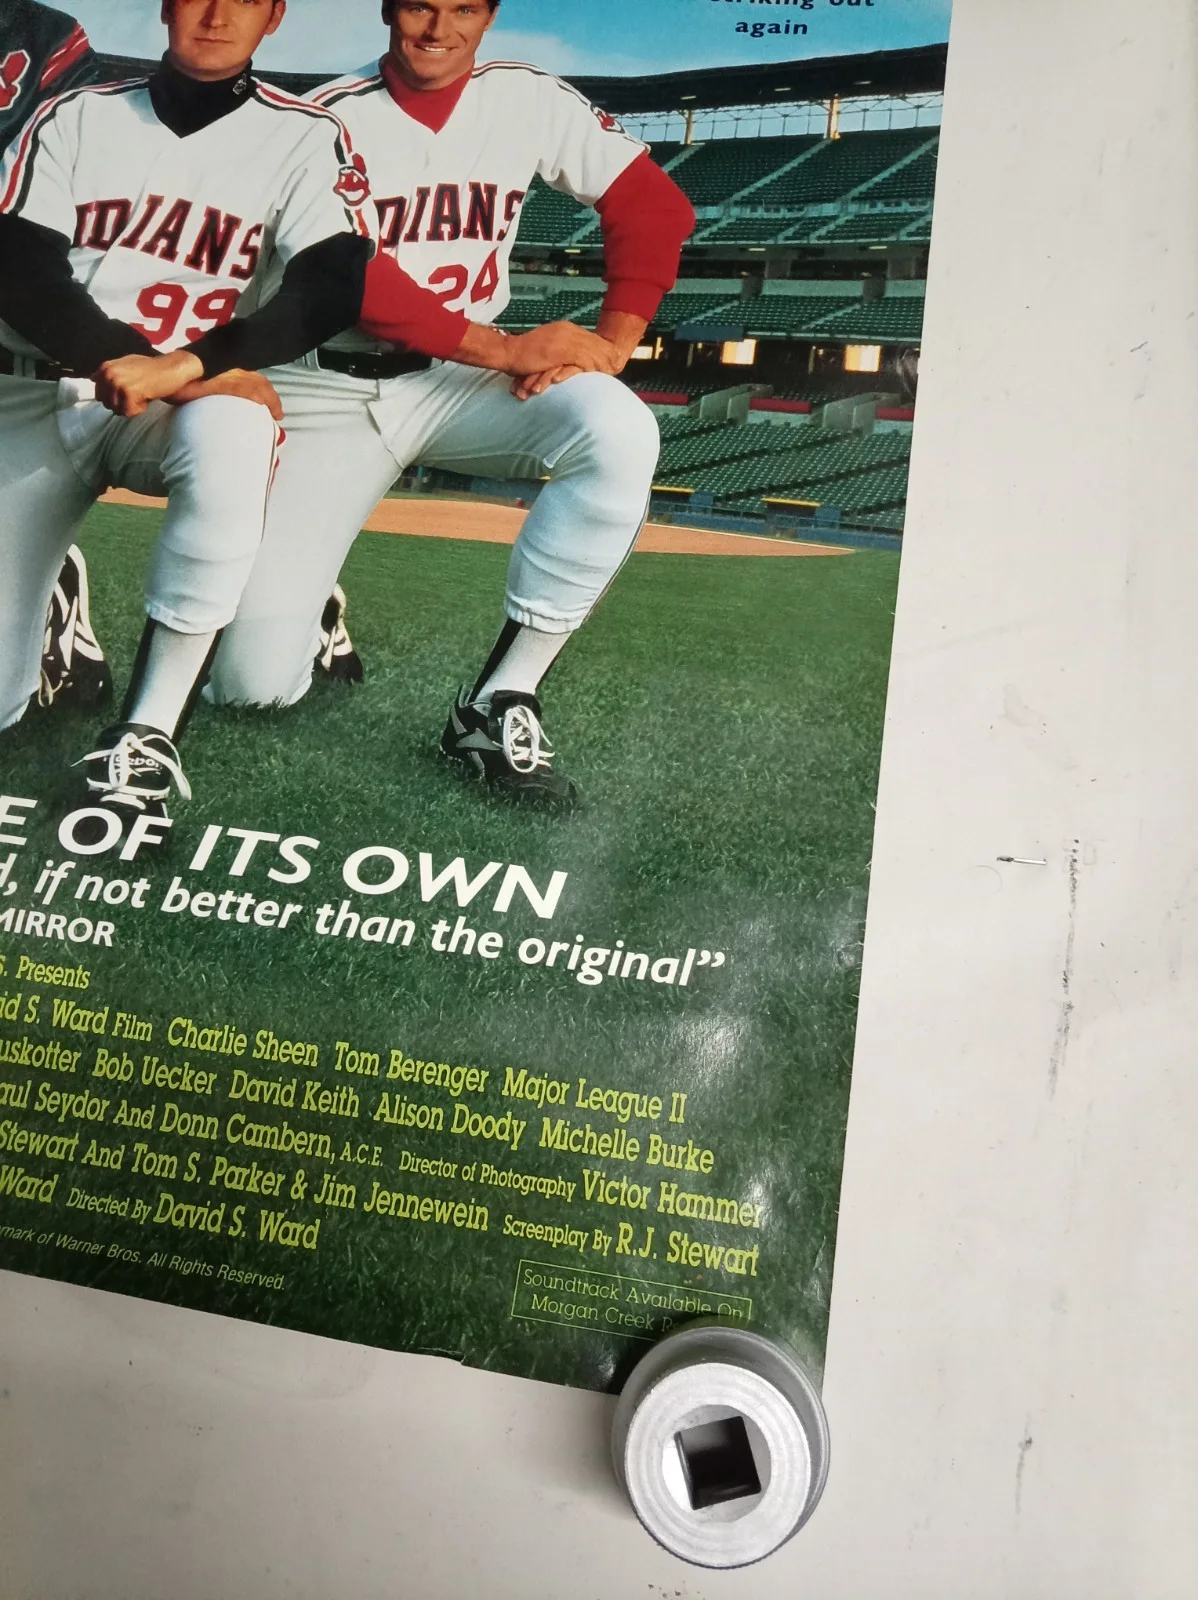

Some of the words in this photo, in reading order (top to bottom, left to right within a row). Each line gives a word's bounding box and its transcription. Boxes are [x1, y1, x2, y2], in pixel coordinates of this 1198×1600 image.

[735, 19, 808, 38] again
[129, 282, 241, 345] 99
[58, 807, 173, 861] OF
[188, 824, 320, 884] ITS
[342, 845, 568, 919] OWN
[33, 859, 77, 905] if
[74, 873, 151, 909] not
[160, 876, 303, 929] better
[315, 900, 416, 947] than
[431, 915, 504, 959] the
[15, 955, 91, 990] Presents
[24, 994, 41, 1024] S.
[52, 998, 110, 1035] Ward
[112, 1012, 153, 1042] Film
[167, 1016, 248, 1056] Charlie
[252, 1029, 319, 1067] Sheen
[335, 1041, 380, 1076] Tom
[386, 1049, 489, 1097] Berenger
[501, 1066, 570, 1109] Major
[575, 1078, 663, 1123] League
[92, 1048, 135, 1082] Bob
[141, 1055, 218, 1095] Uecker
[228, 1070, 297, 1108] David
[301, 1080, 360, 1118] Keith
[373, 1092, 444, 1131] Alison
[451, 1103, 527, 1151] Doody
[538, 1116, 640, 1162] Michelle
[646, 1133, 715, 1174] Burke
[0, 1119, 80, 1162] Stewart
[81, 1140, 125, 1170] And
[131, 1143, 178, 1180] Tom
[183, 1151, 201, 1184] S.
[209, 1156, 286, 1197] Parker
[290, 1169, 308, 1200] &
[314, 1173, 357, 1209] Jim
[363, 1181, 489, 1231] Jennewein
[503, 1214, 590, 1253] Screenplay
[592, 1228, 613, 1257] By
[615, 1222, 657, 1260] R.J.
[666, 1230, 760, 1277] Stewart
[34, 1082, 110, 1122] Seydor
[113, 1100, 156, 1130] And
[159, 1102, 220, 1140] Donn
[226, 1113, 335, 1165] Cambern,
[339, 1141, 383, 1167] A.C.E.
[398, 1150, 459, 1179] Director
[462, 1161, 478, 1182] of
[479, 1163, 577, 1202] Photography
[582, 1169, 651, 1210] Victor
[657, 1181, 762, 1229] Hammer
[0, 1164, 59, 1203] Ward
[66, 1187, 130, 1217] Directed
[131, 1199, 152, 1225] By
[153, 1193, 226, 1234] David
[228, 1205, 246, 1238] S.
[257, 1209, 322, 1251] Ward
[36, 1232, 56, 1245] of
[55, 1233, 105, 1256] Warner
[107, 1242, 141, 1264] Bros.
[147, 1251, 167, 1269] All
[168, 1254, 215, 1278] Rights
[216, 1264, 286, 1291] Reserved.
[523, 1268, 620, 1300] Soundtrack
[625, 1287, 712, 1314] Available
[530, 1293, 599, 1321] Morgan
[605, 1306, 655, 1331] Creek
